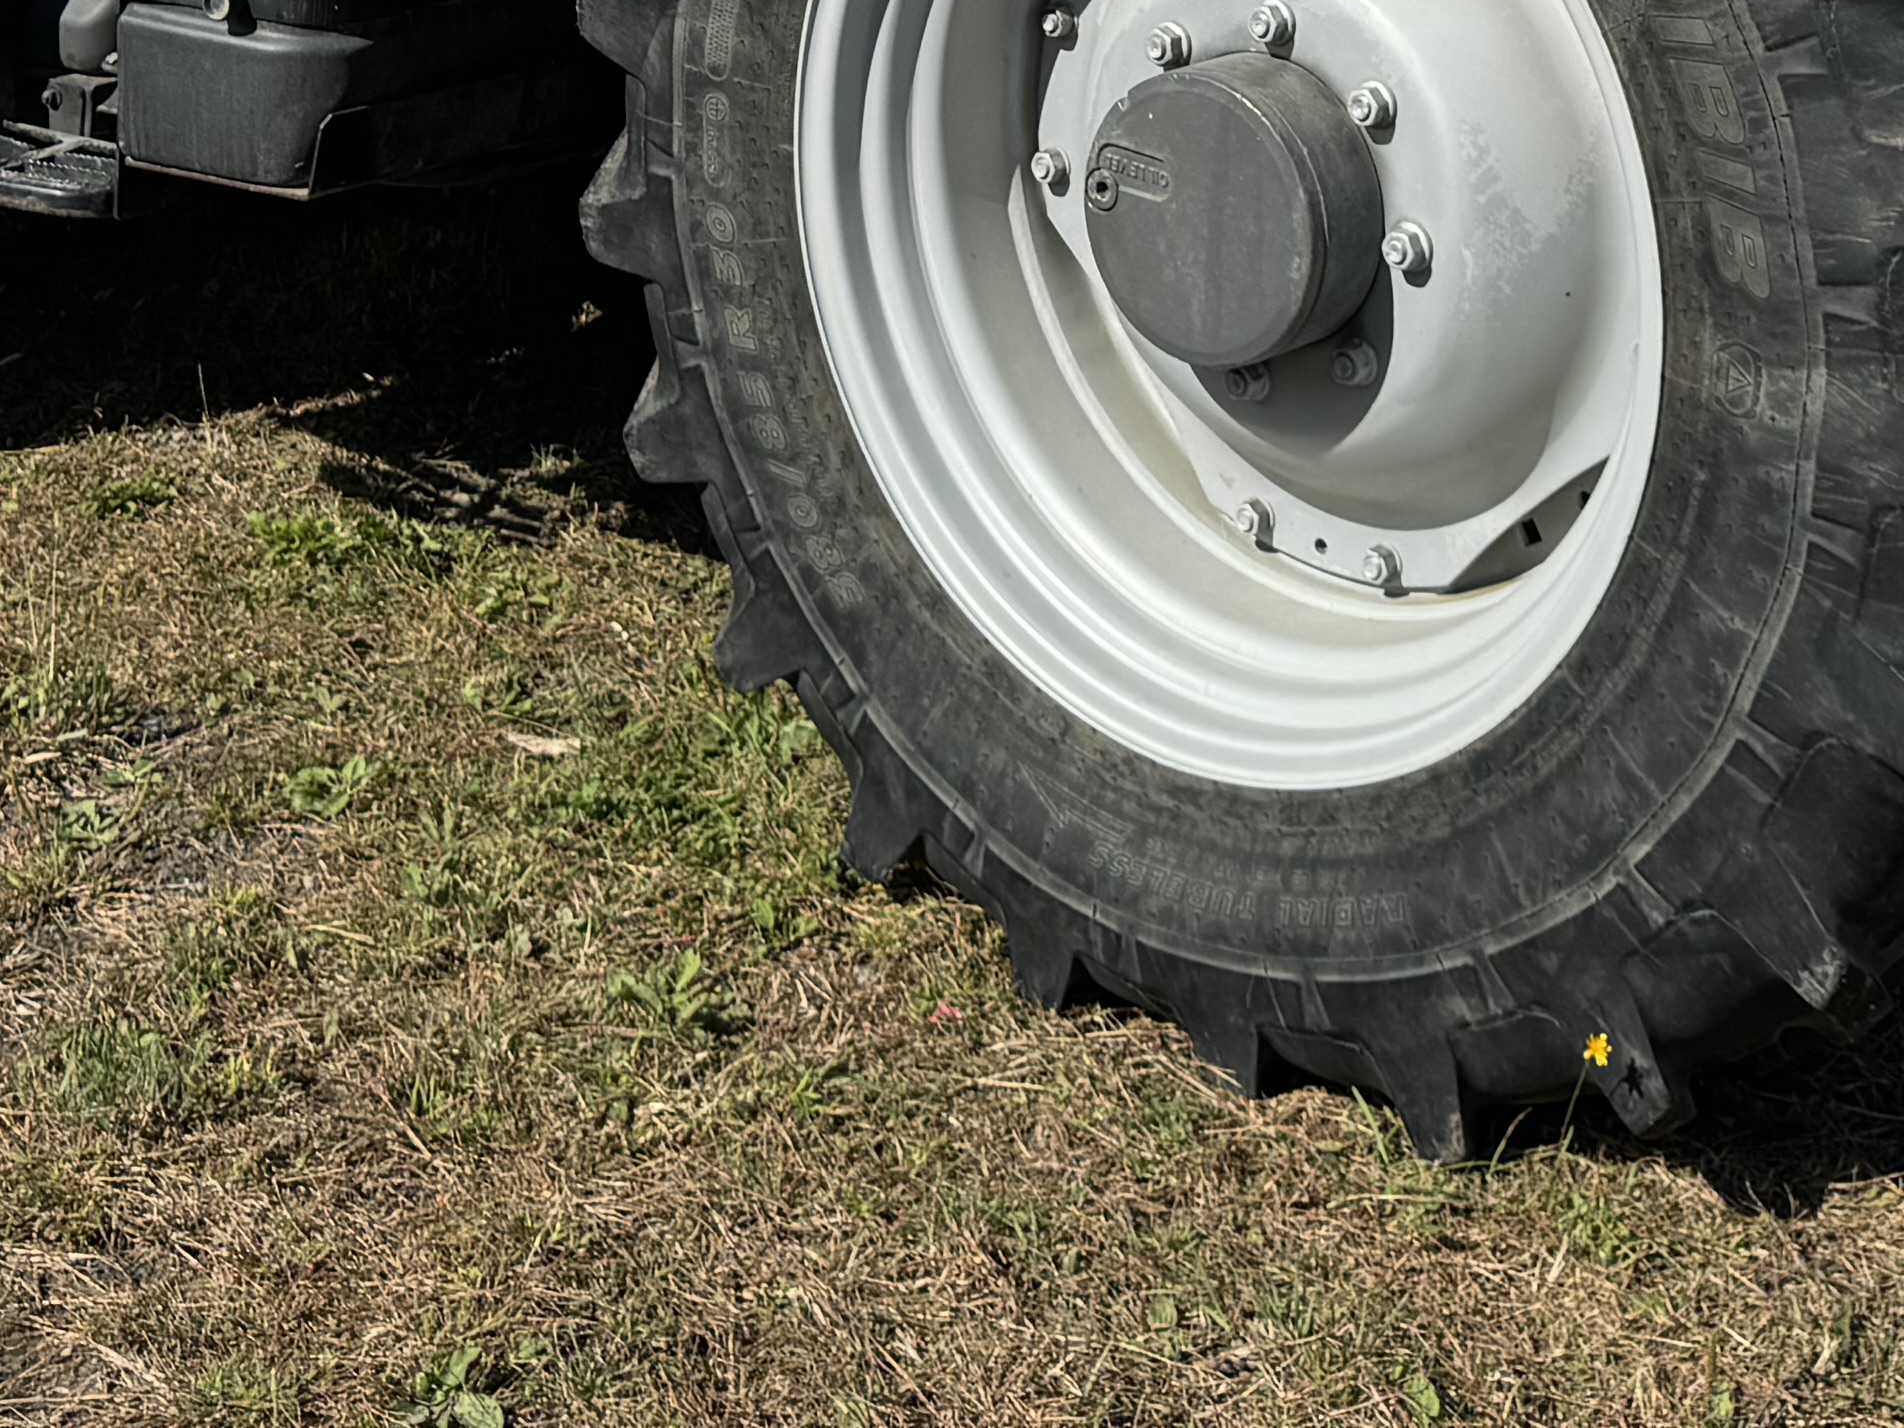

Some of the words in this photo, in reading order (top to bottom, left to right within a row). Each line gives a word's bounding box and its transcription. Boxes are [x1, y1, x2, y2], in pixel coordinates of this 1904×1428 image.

[705, 202, 744, 287] 30
[723, 304, 759, 352] R
[1088, 842, 1257, 920] TUBELESS
[1279, 893, 1409, 927] RADIAL
